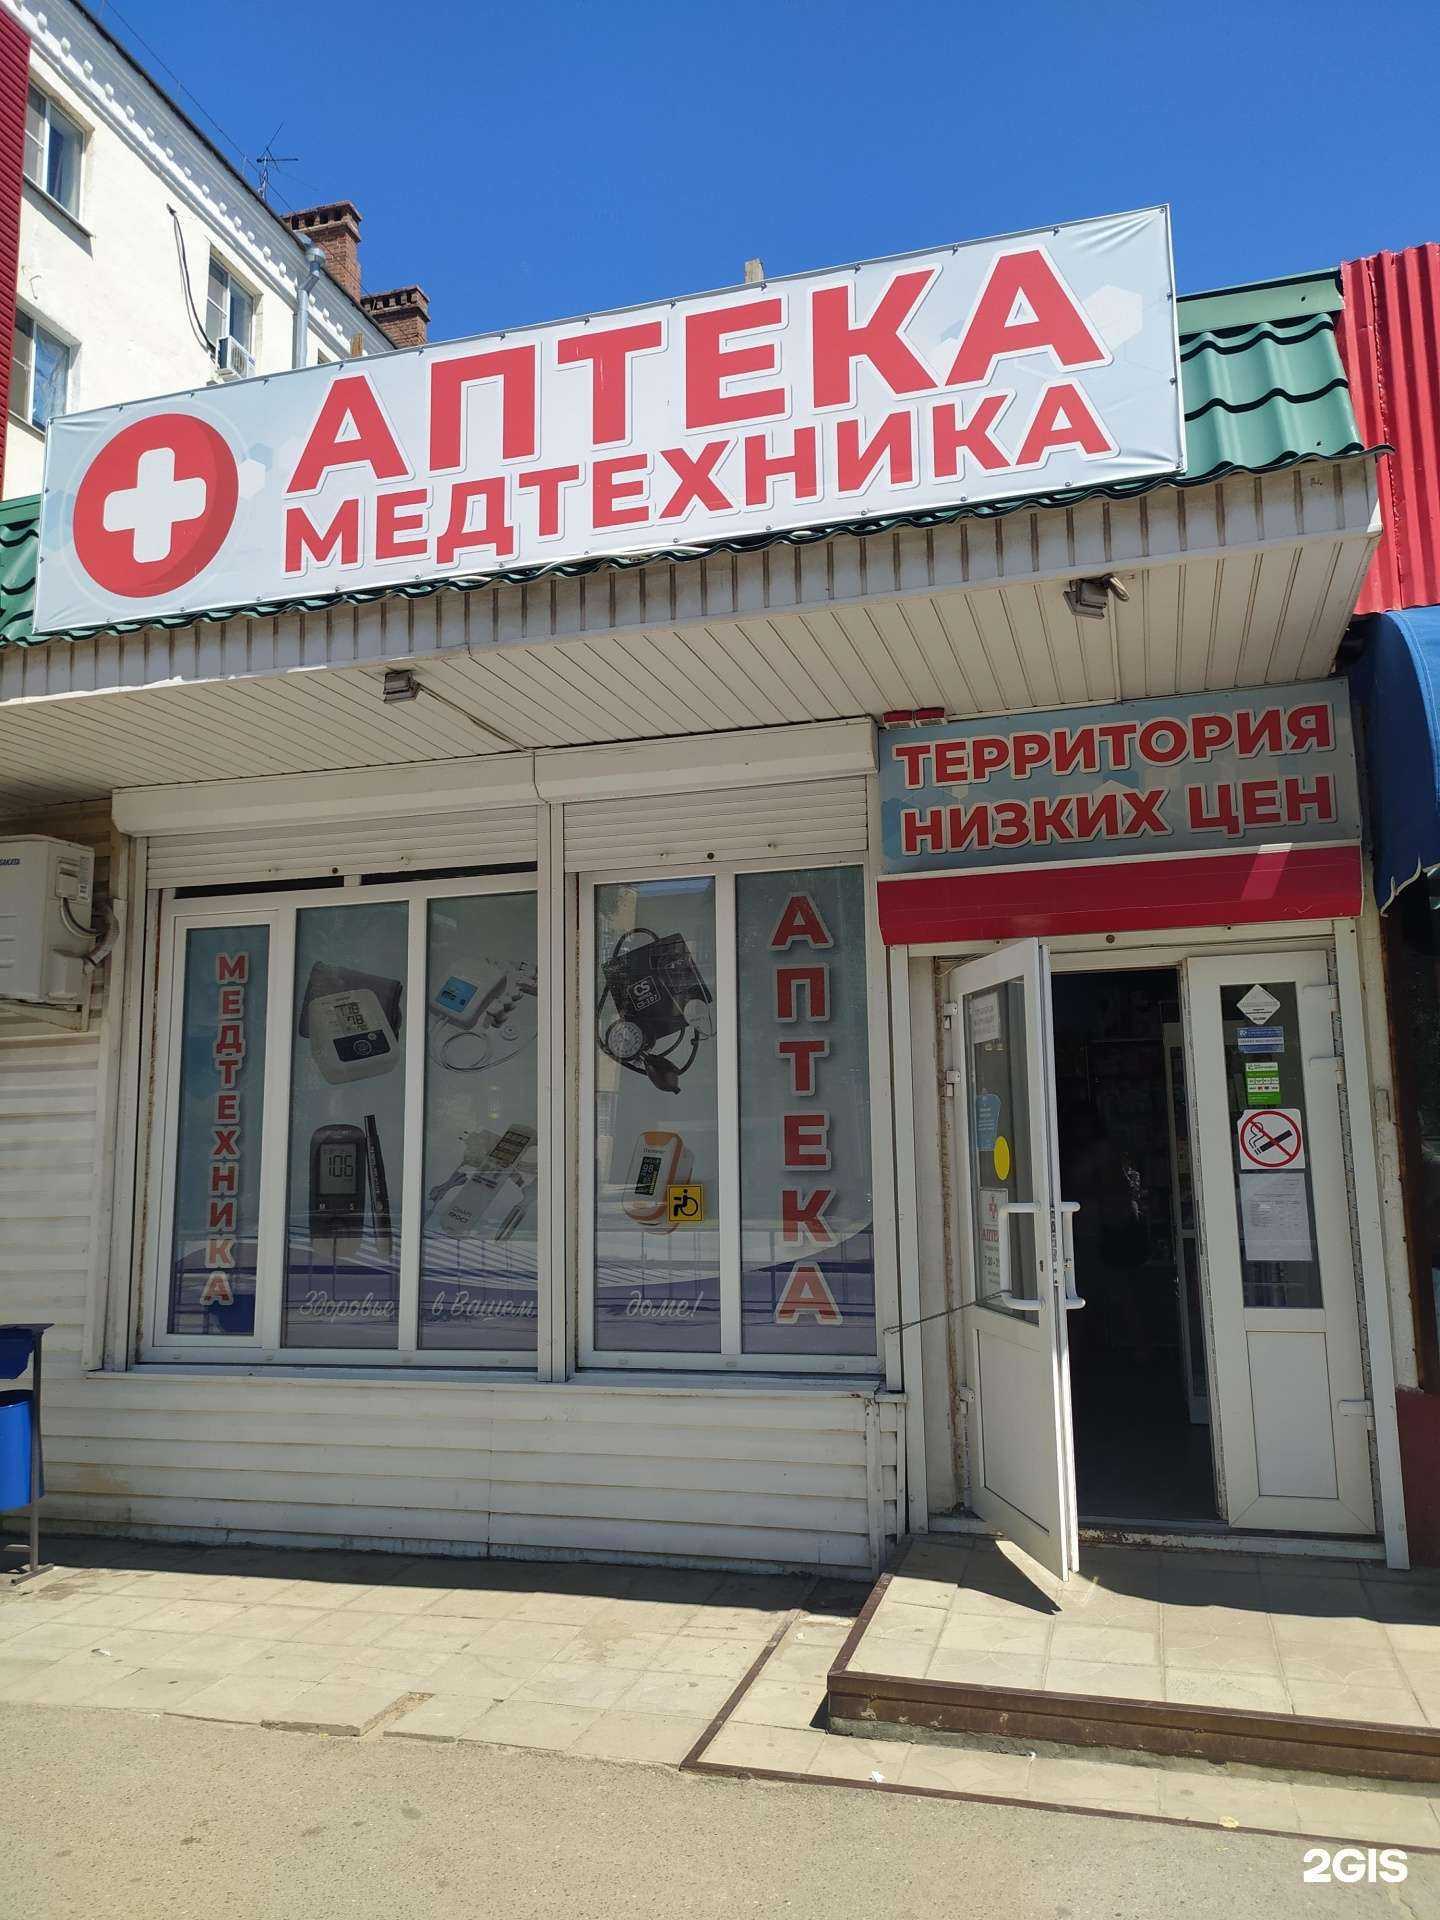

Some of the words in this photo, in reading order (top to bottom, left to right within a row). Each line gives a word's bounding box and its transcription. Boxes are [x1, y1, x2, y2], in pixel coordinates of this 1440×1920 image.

[285, 248, 1104, 494] АПТЕКА
[284, 382, 1113, 573] МЕДТЕХНИКА
[895, 704, 1332, 787] ТЕРРИТОРИЯ
[903, 790, 1169, 853] НИЗКИХ
[1188, 775, 1333, 836] ЦЕН
[204, 953, 247, 1303] МЕДТЕХНИКА
[327, 1154, 354, 1178] 106
[771, 895, 839, 1321] АПТЕКА
[299, 1290, 396, 1323] Здоровье
[431, 1291, 446, 1316] в
[450, 1290, 537, 1321] Вашем
[625, 1290, 703, 1319] доме!
